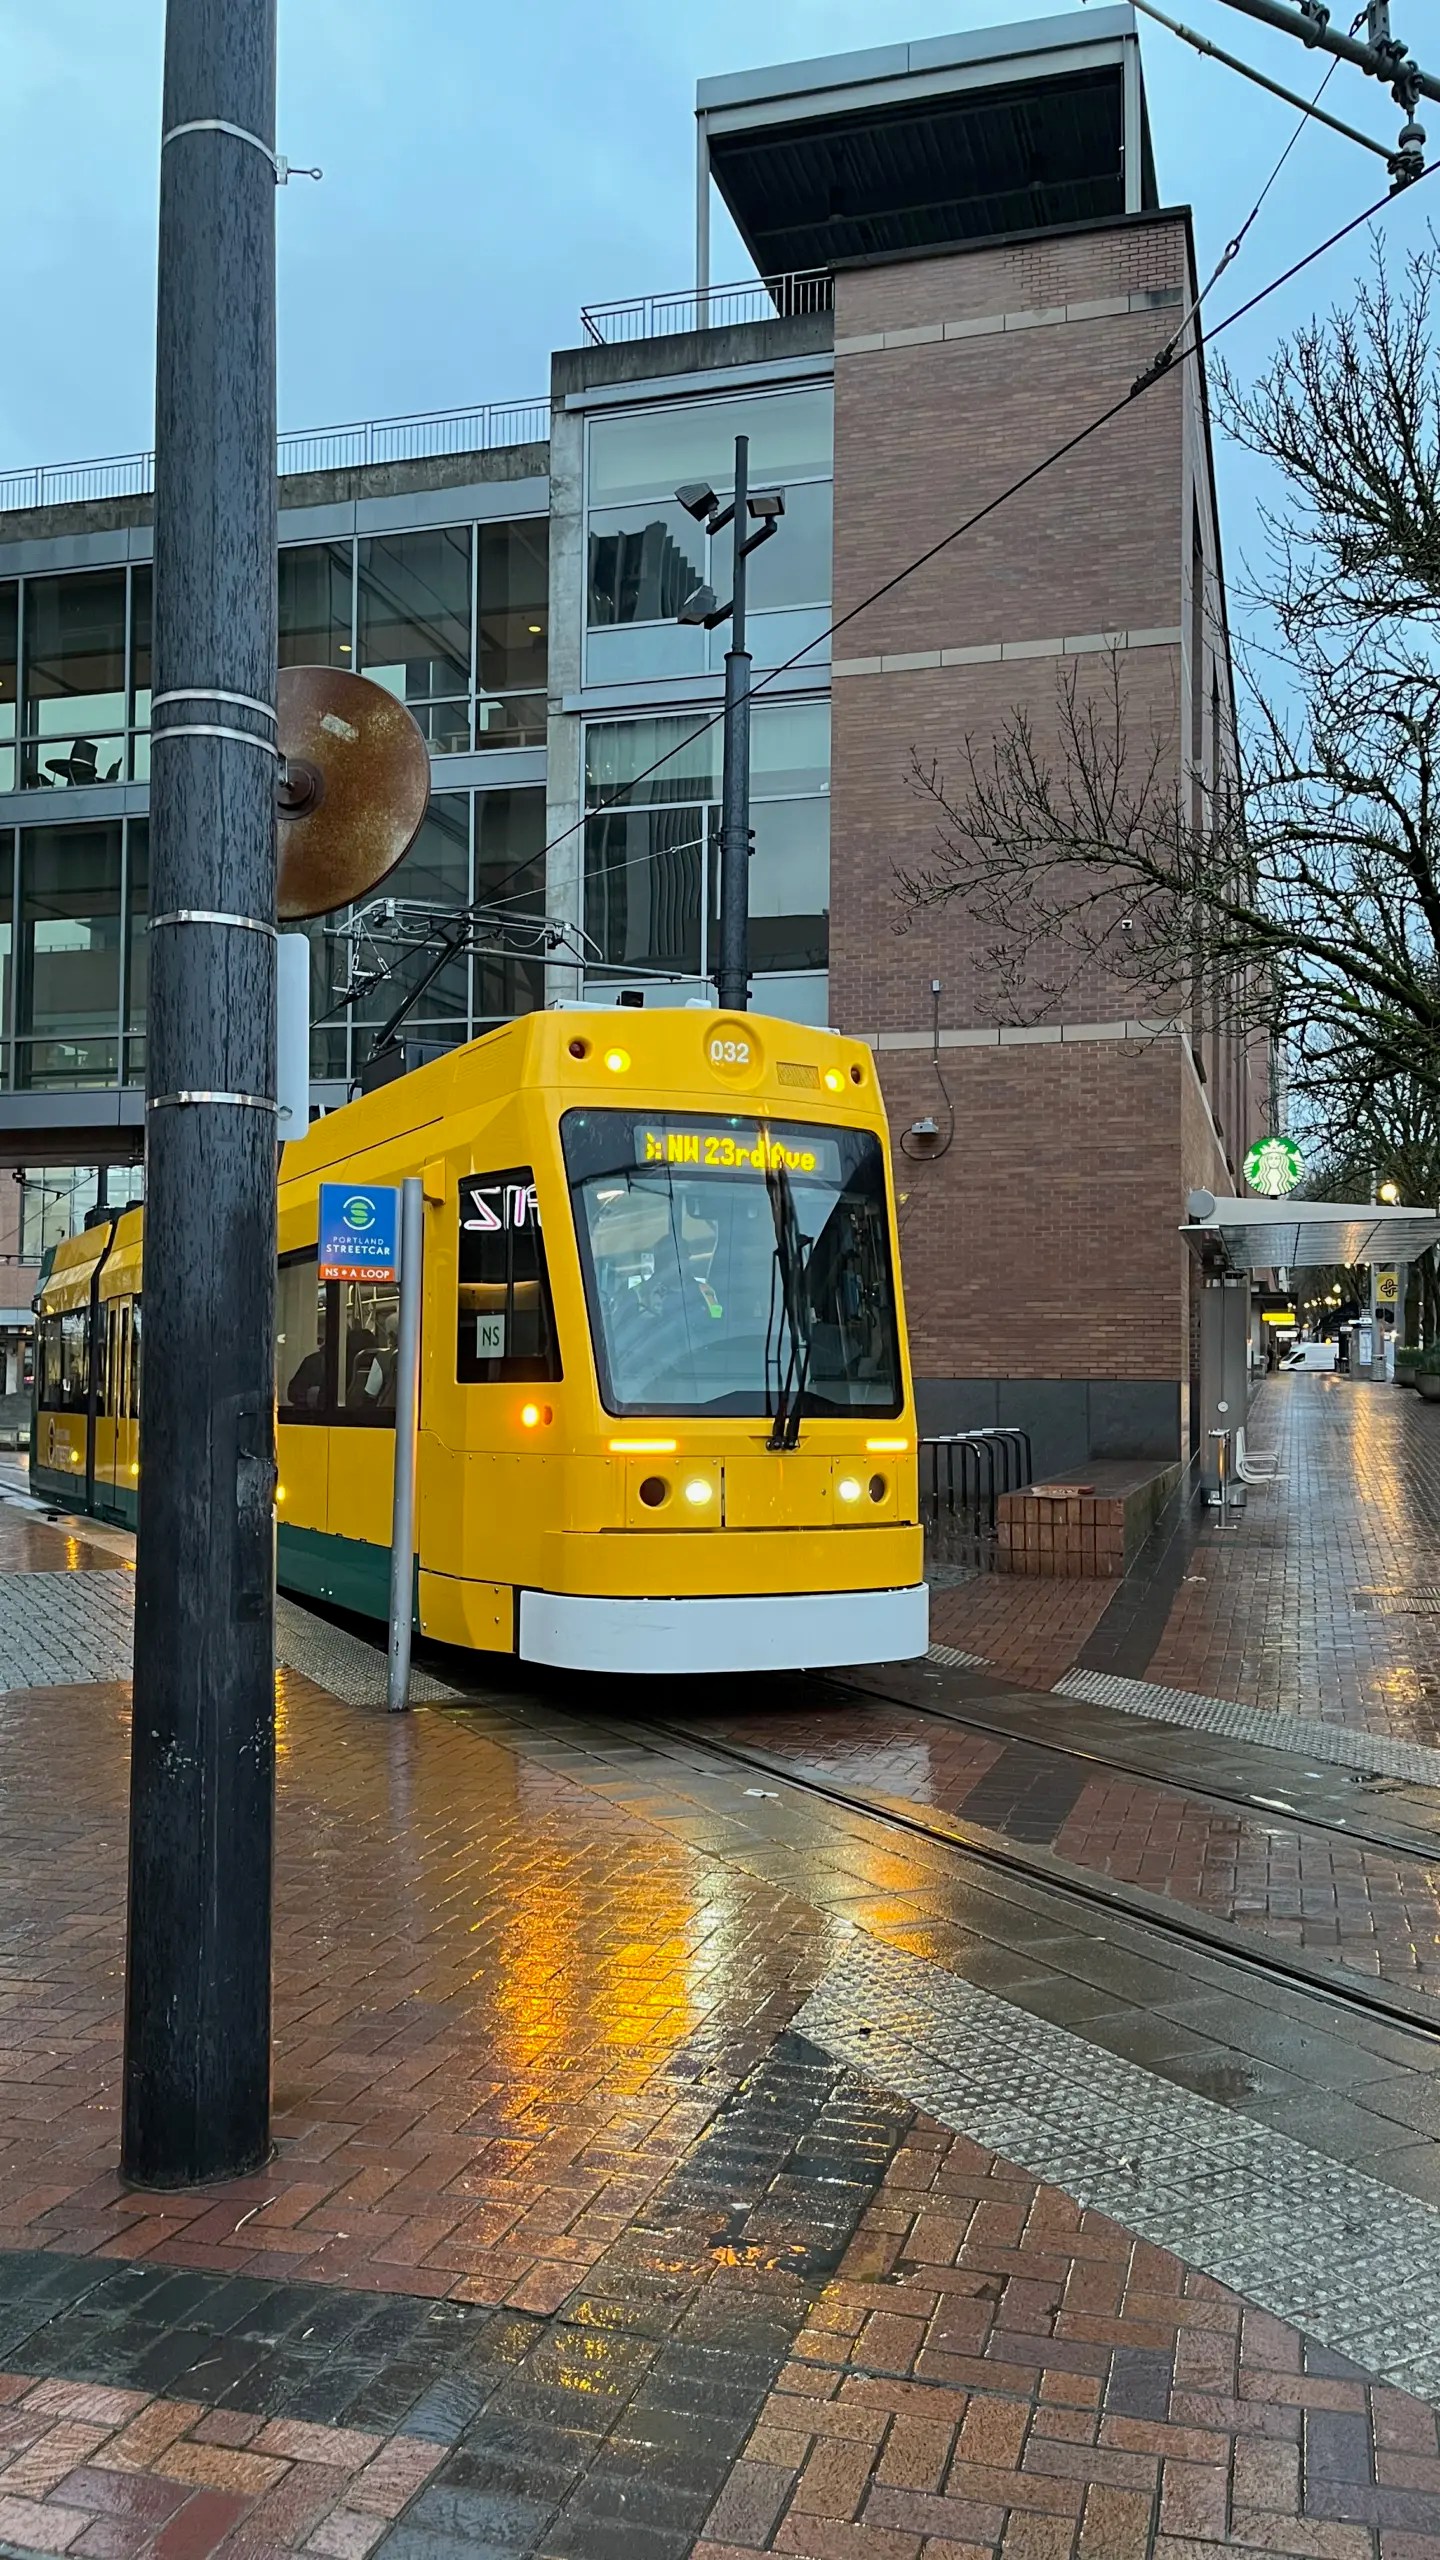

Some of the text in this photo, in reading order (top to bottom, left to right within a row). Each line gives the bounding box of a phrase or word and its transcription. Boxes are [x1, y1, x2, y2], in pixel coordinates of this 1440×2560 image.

[710, 1040, 749, 1063] 032
[667, 1134, 699, 1163] NW
[704, 1136, 766, 1168] 23rd
[770, 1142, 816, 1172] Ave
[332, 1236, 384, 1246] PORTLAND
[326, 1244, 390, 1256] STREETCAR
[325, 1268, 390, 1279] NS A LOOP
[482, 1326, 500, 1347] NS
